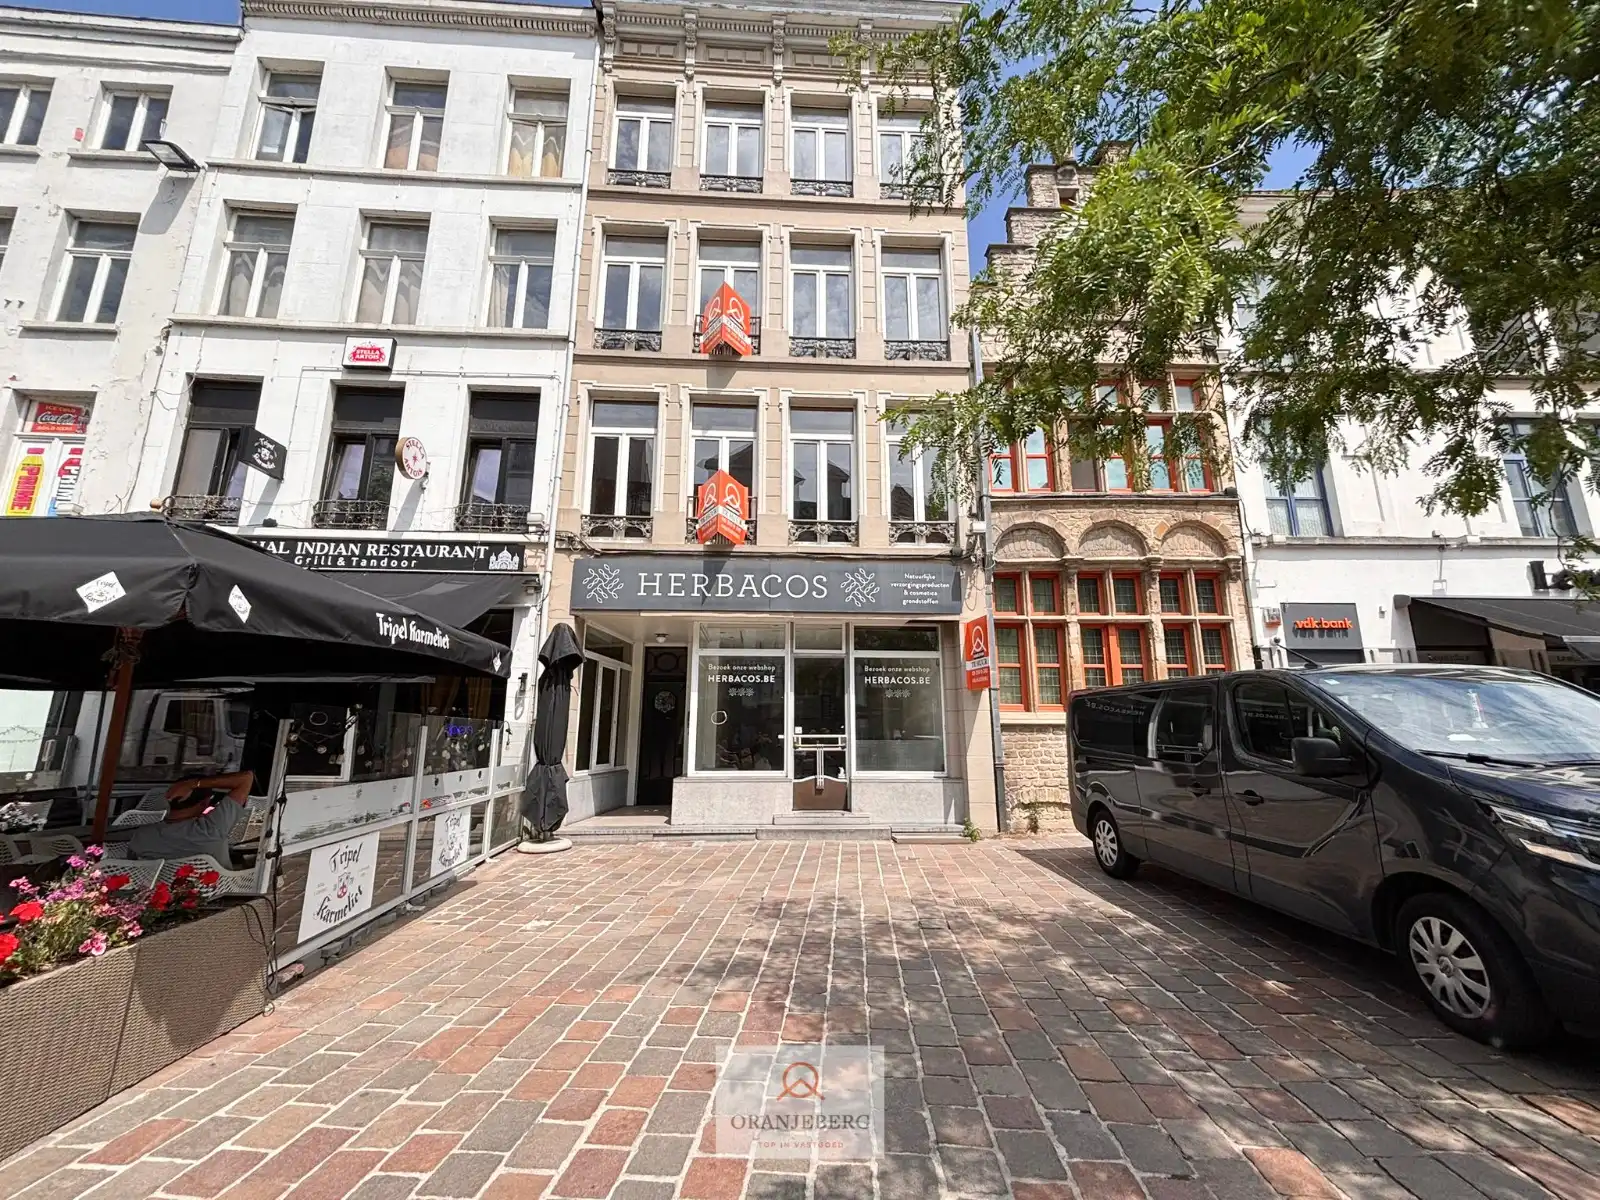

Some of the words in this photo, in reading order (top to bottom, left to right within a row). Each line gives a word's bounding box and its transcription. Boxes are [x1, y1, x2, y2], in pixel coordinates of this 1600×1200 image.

[11, 465, 41, 511] PRIME
[295, 541, 361, 556] INDIAN
[365, 543, 489, 559] RESTAURANT
[294, 555, 332, 566] Grill
[337, 557, 346, 567] &
[351, 556, 417, 568] Tandoor
[637, 572, 828, 598] HERBACOS
[890, 581, 950, 589] verzorgingsproducten
[902, 598, 939, 606] grondstoffen
[1295, 616, 1319, 628] vdk
[1320, 617, 1353, 628] bank
[376, 612, 408, 645] Tripel
[409, 620, 450, 650] Karmeliet
[708, 663, 731, 671] Bezoek
[748, 664, 776, 673] webshop
[864, 664, 887, 672] Bezoek
[903, 666, 931, 674] webshop
[708, 674, 776, 683] HERBACOS.BE
[864, 676, 931, 684] HERBACOS.BE
[329, 842, 364, 873] Tripel
